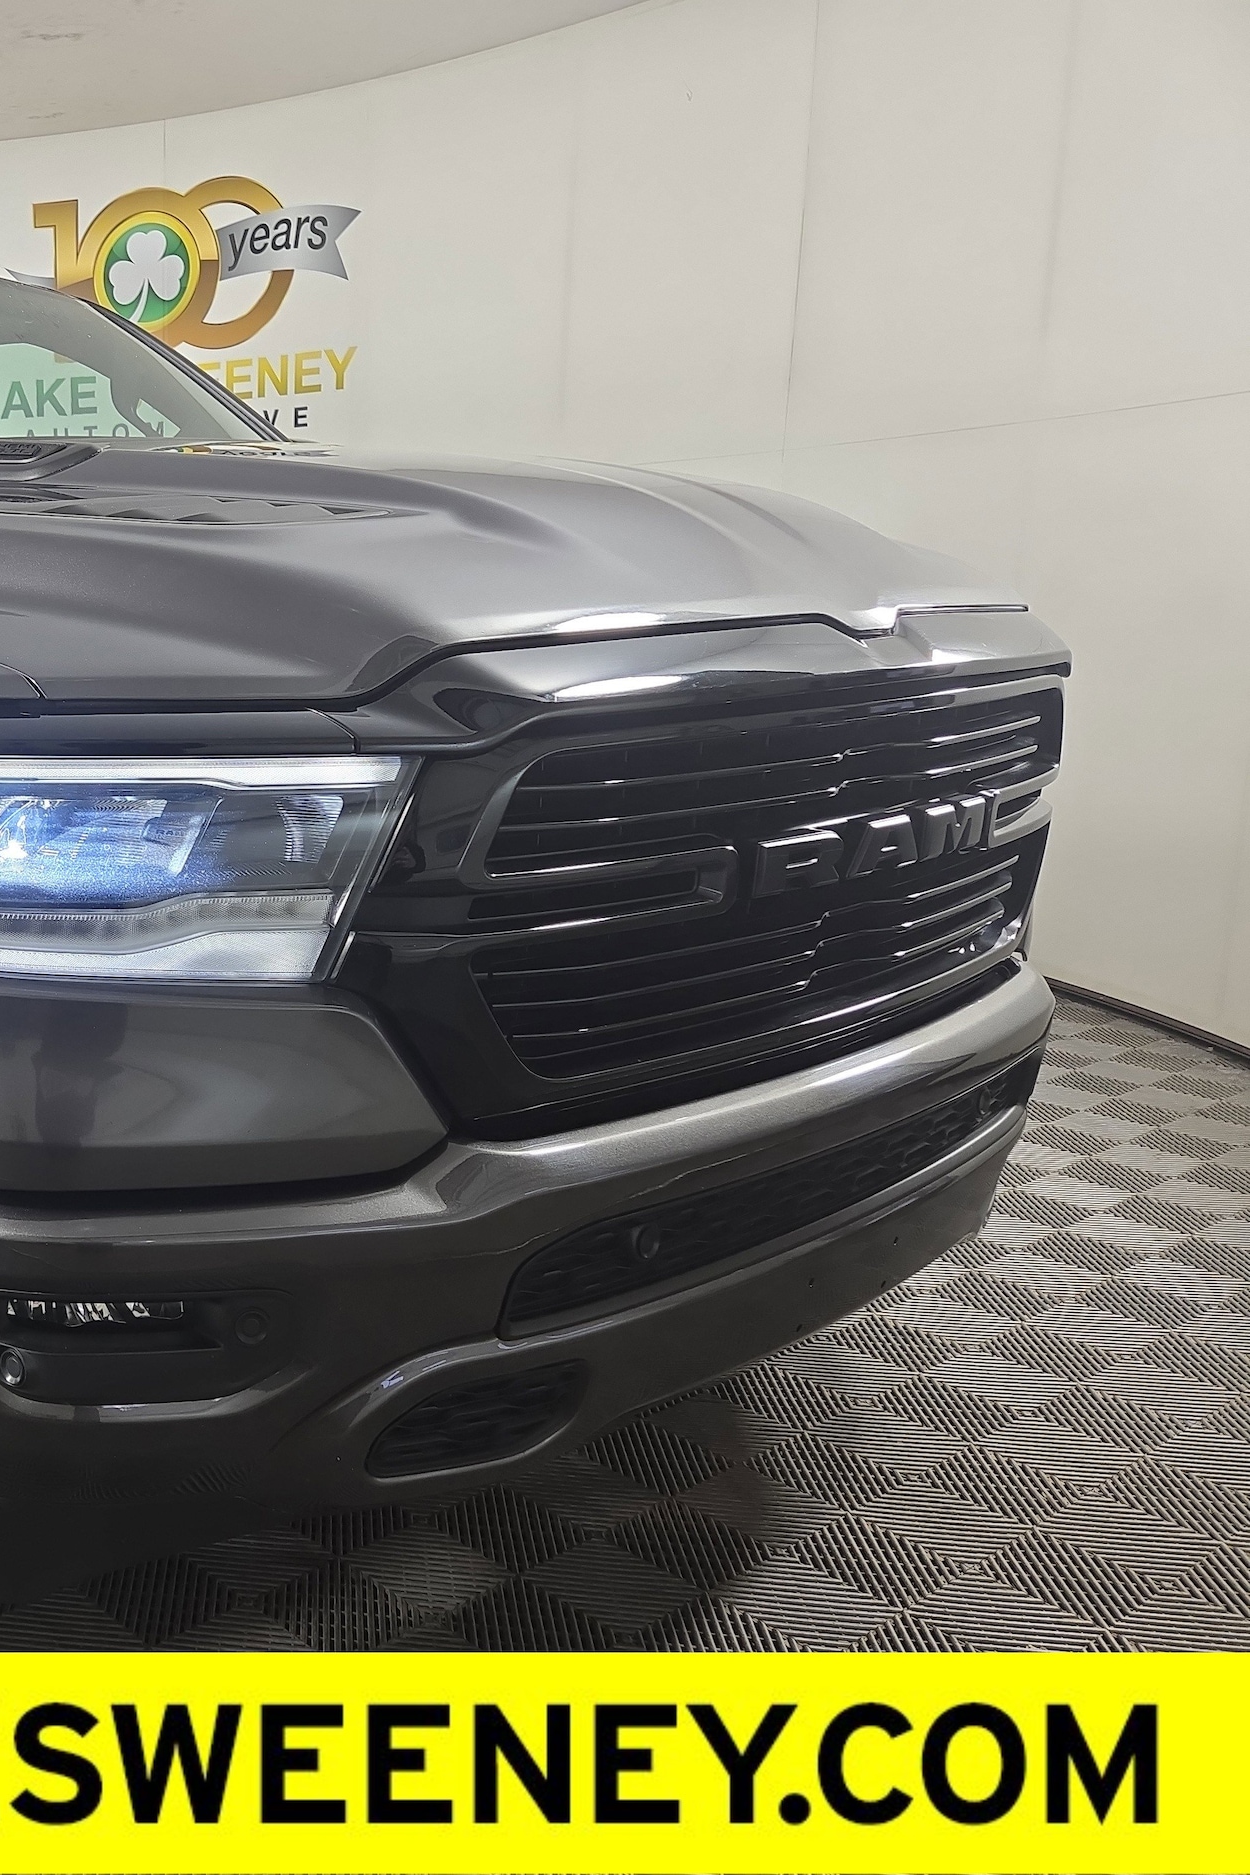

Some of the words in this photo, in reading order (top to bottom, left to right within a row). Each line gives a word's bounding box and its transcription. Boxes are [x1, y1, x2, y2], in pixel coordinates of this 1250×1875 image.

[228, 213, 329, 272] years
[198, 345, 358, 400] ENEY
[751, 796, 987, 899] RAM
